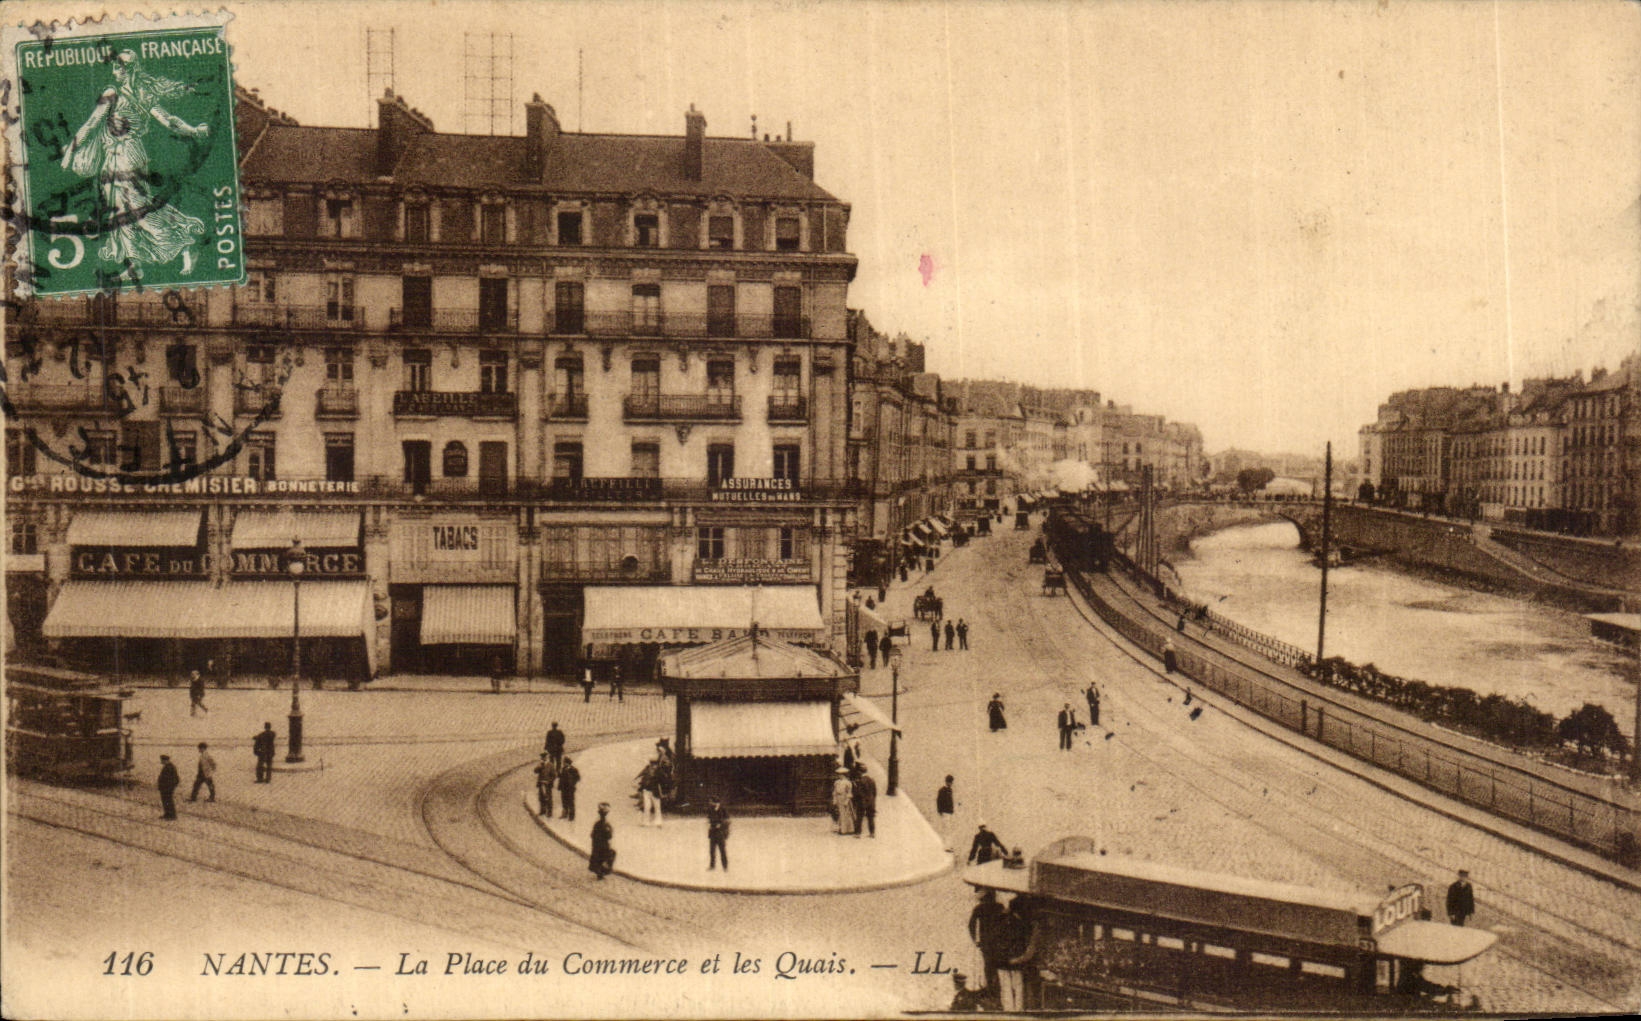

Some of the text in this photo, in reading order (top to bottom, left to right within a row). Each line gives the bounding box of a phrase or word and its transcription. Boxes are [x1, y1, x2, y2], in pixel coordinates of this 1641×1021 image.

[141, 37, 222, 59] FRANÇAISE
[214, 185, 236, 269] POSTES
[144, 476, 256, 494] CHEMISIER
[267, 480, 359, 493] BONNETERIE
[721, 478, 792, 489] ASSURANCES
[712, 492, 767, 501] MUTUELLES
[433, 526, 479, 550] TABACS
[170, 560, 193, 573] DU
[202, 553, 359, 574] COMMRCE
[641, 628, 699, 640] CAFE
